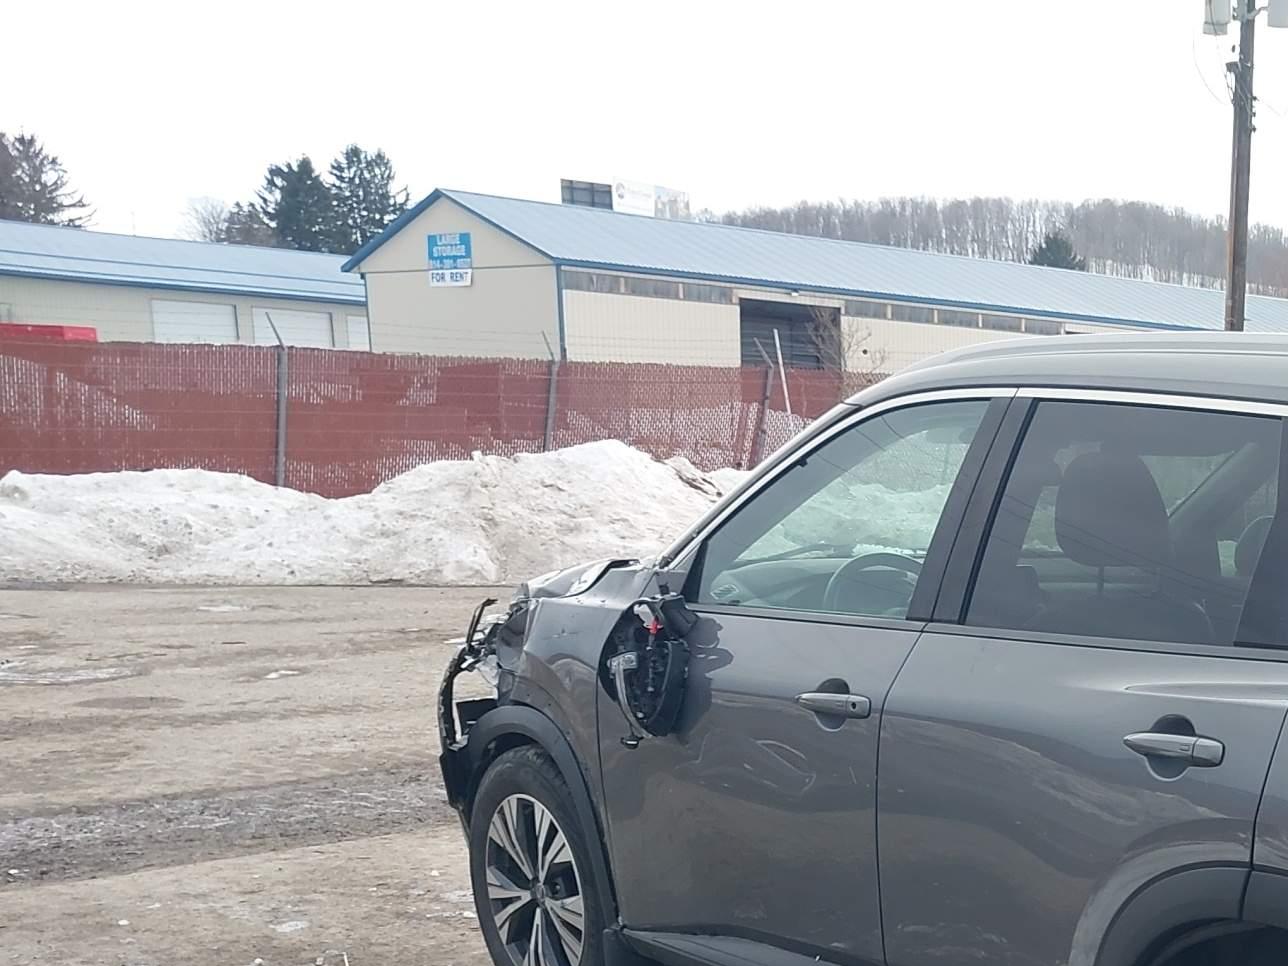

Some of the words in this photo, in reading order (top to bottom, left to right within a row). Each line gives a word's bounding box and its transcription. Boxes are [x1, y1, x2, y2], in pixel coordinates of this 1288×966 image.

[432, 245, 465, 257] STORAGE
[431, 272, 446, 282] FOR
[449, 271, 469, 282] RENT
